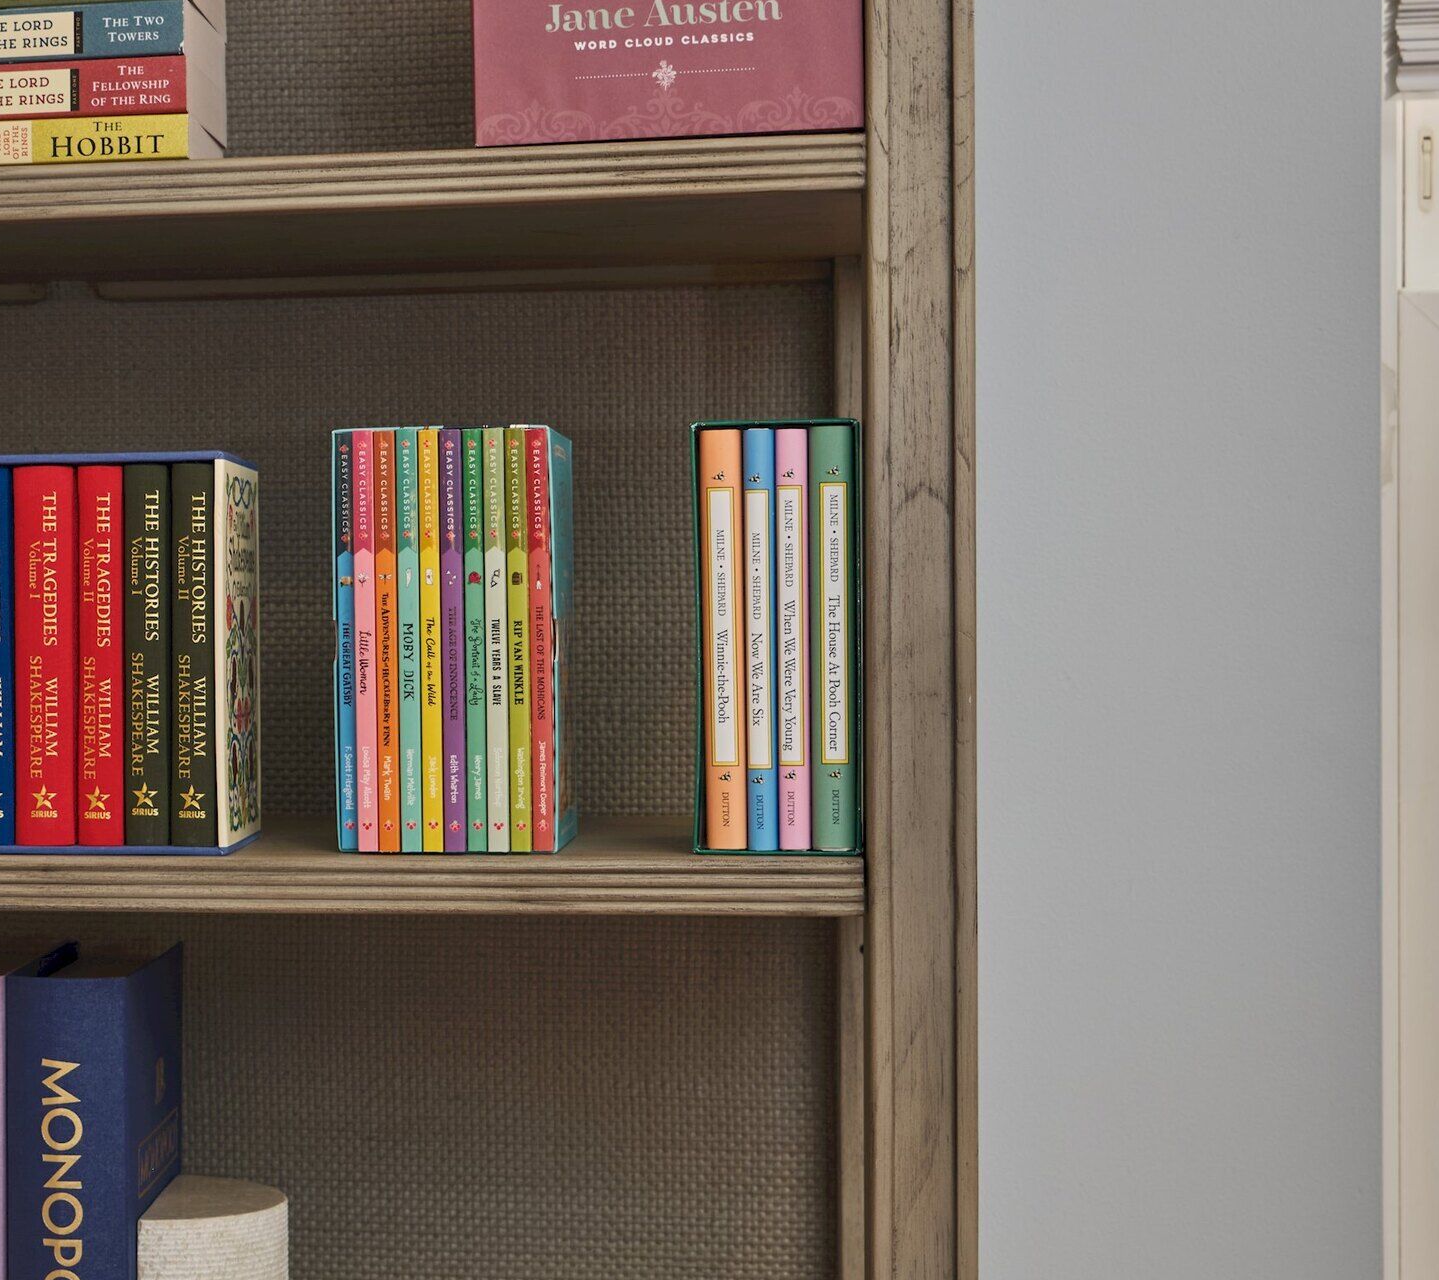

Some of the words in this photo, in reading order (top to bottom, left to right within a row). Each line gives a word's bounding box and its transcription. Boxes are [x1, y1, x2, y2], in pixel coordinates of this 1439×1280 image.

[14, 20, 53, 31] LORD
[545, 3, 634, 33] Jane
[23, 36, 67, 48] RINGS
[574, 39, 617, 51] WORD
[625, 36, 674, 48] CLOUD
[681, 32, 755, 45] CLASSICS
[10, 77, 49, 89] LORD
[19, 94, 64, 105] RINGS
[51, 135, 165, 158] HOBBIT
[42, 492, 57, 532] THE
[96, 492, 111, 533] THE
[144, 490, 159, 531] THE
[191, 492, 206, 532] THE
[716, 529, 725, 561] MILNE
[752, 533, 760, 565] MILNE
[42, 539, 58, 646] TRAGEDIES
[97, 540, 112, 648] TRAGEDIES
[144, 537, 160, 641] HISTORIES
[192, 539, 206, 644] HISTORIES
[716, 572, 726, 616] SHEPARD
[752, 576, 761, 620] SHEPARD
[784, 600, 795, 635] When
[829, 595, 840, 618] The
[403, 624, 414, 662] MOBY
[491, 619, 500, 645] TWELVE
[514, 621, 522, 639] RIP
[829, 622, 840, 658] House
[492, 649, 501, 671] YEARS
[514, 643, 522, 660] VAN
[752, 633, 762, 660] Now
[784, 638, 795, 655] We
[717, 630, 729, 723] Winnie-the-Pooh
[752, 662, 763, 679] We
[784, 659, 795, 686] Were
[829, 662, 840, 675] At
[404, 671, 414, 701] DICK
[493, 683, 501, 706] SLAVE
[515, 665, 524, 705] WINKLE
[752, 684, 763, 704] Are
[781, 690, 795, 712] Very
[829, 680, 841, 708] Pooh
[29, 656, 43, 778] SHAKESPEARE
[44, 678, 58, 756] WILLIAM
[83, 657, 96, 779] SHAKESPEARE
[98, 679, 112, 758] WILLIAM
[131, 653, 144, 776] SHAKESPEARE
[145, 674, 160, 754] WILLIAM
[179, 655, 191, 779] SHAKESPEARE
[192, 678, 206, 756] WILLIAM
[752, 709, 763, 726] Six
[782, 717, 796, 751] Young
[830, 712, 841, 751] Corner
[179, 811, 205, 819] SIRIUS
